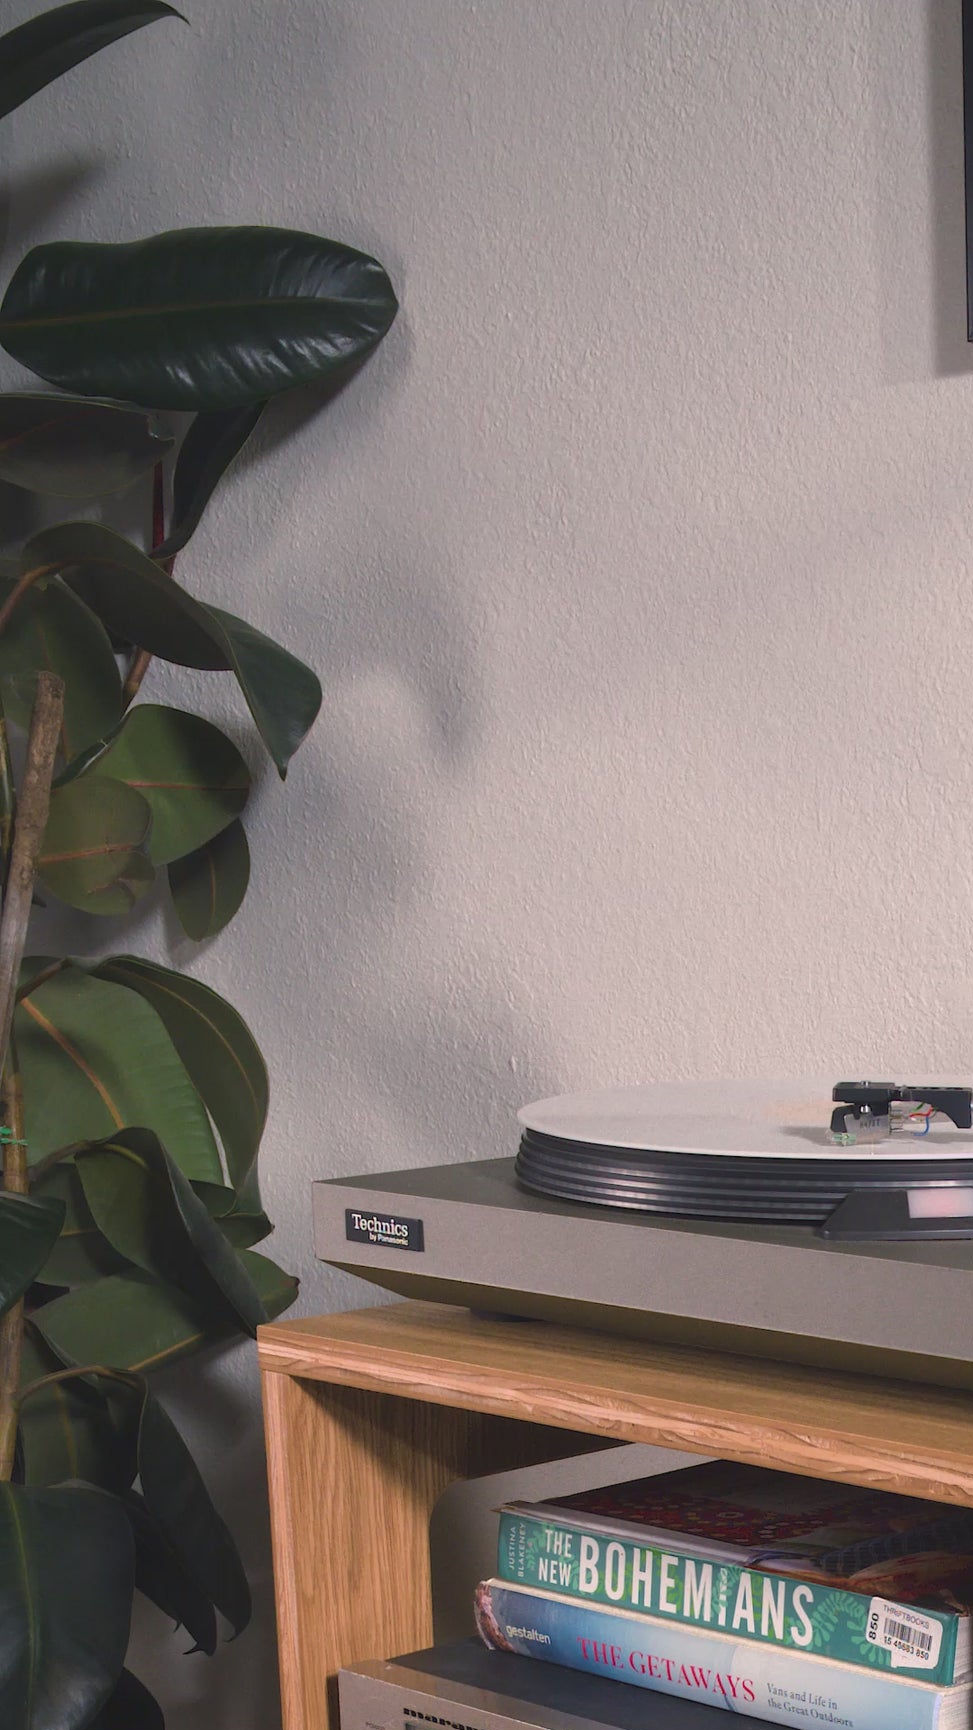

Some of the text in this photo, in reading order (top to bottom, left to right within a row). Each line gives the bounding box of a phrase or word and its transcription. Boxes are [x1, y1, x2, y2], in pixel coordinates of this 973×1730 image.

[351, 1213, 409, 1237] Technics
[369, 1232, 377, 1242] by
[508, 1526, 517, 1571] JUSTINA
[517, 1522, 526, 1578] BLAKENEY
[545, 1529, 573, 1558] THE
[538, 1557, 572, 1588] NEW
[578, 1535, 814, 1647] BOHEMIANS
[505, 1624, 552, 1645] gestalten
[868, 1612, 880, 1640] 850
[576, 1636, 757, 1703] THE GETAWAYS
[767, 1682, 838, 1710] Vans and Life in
[768, 1698, 854, 1728] the Great Outdoors
